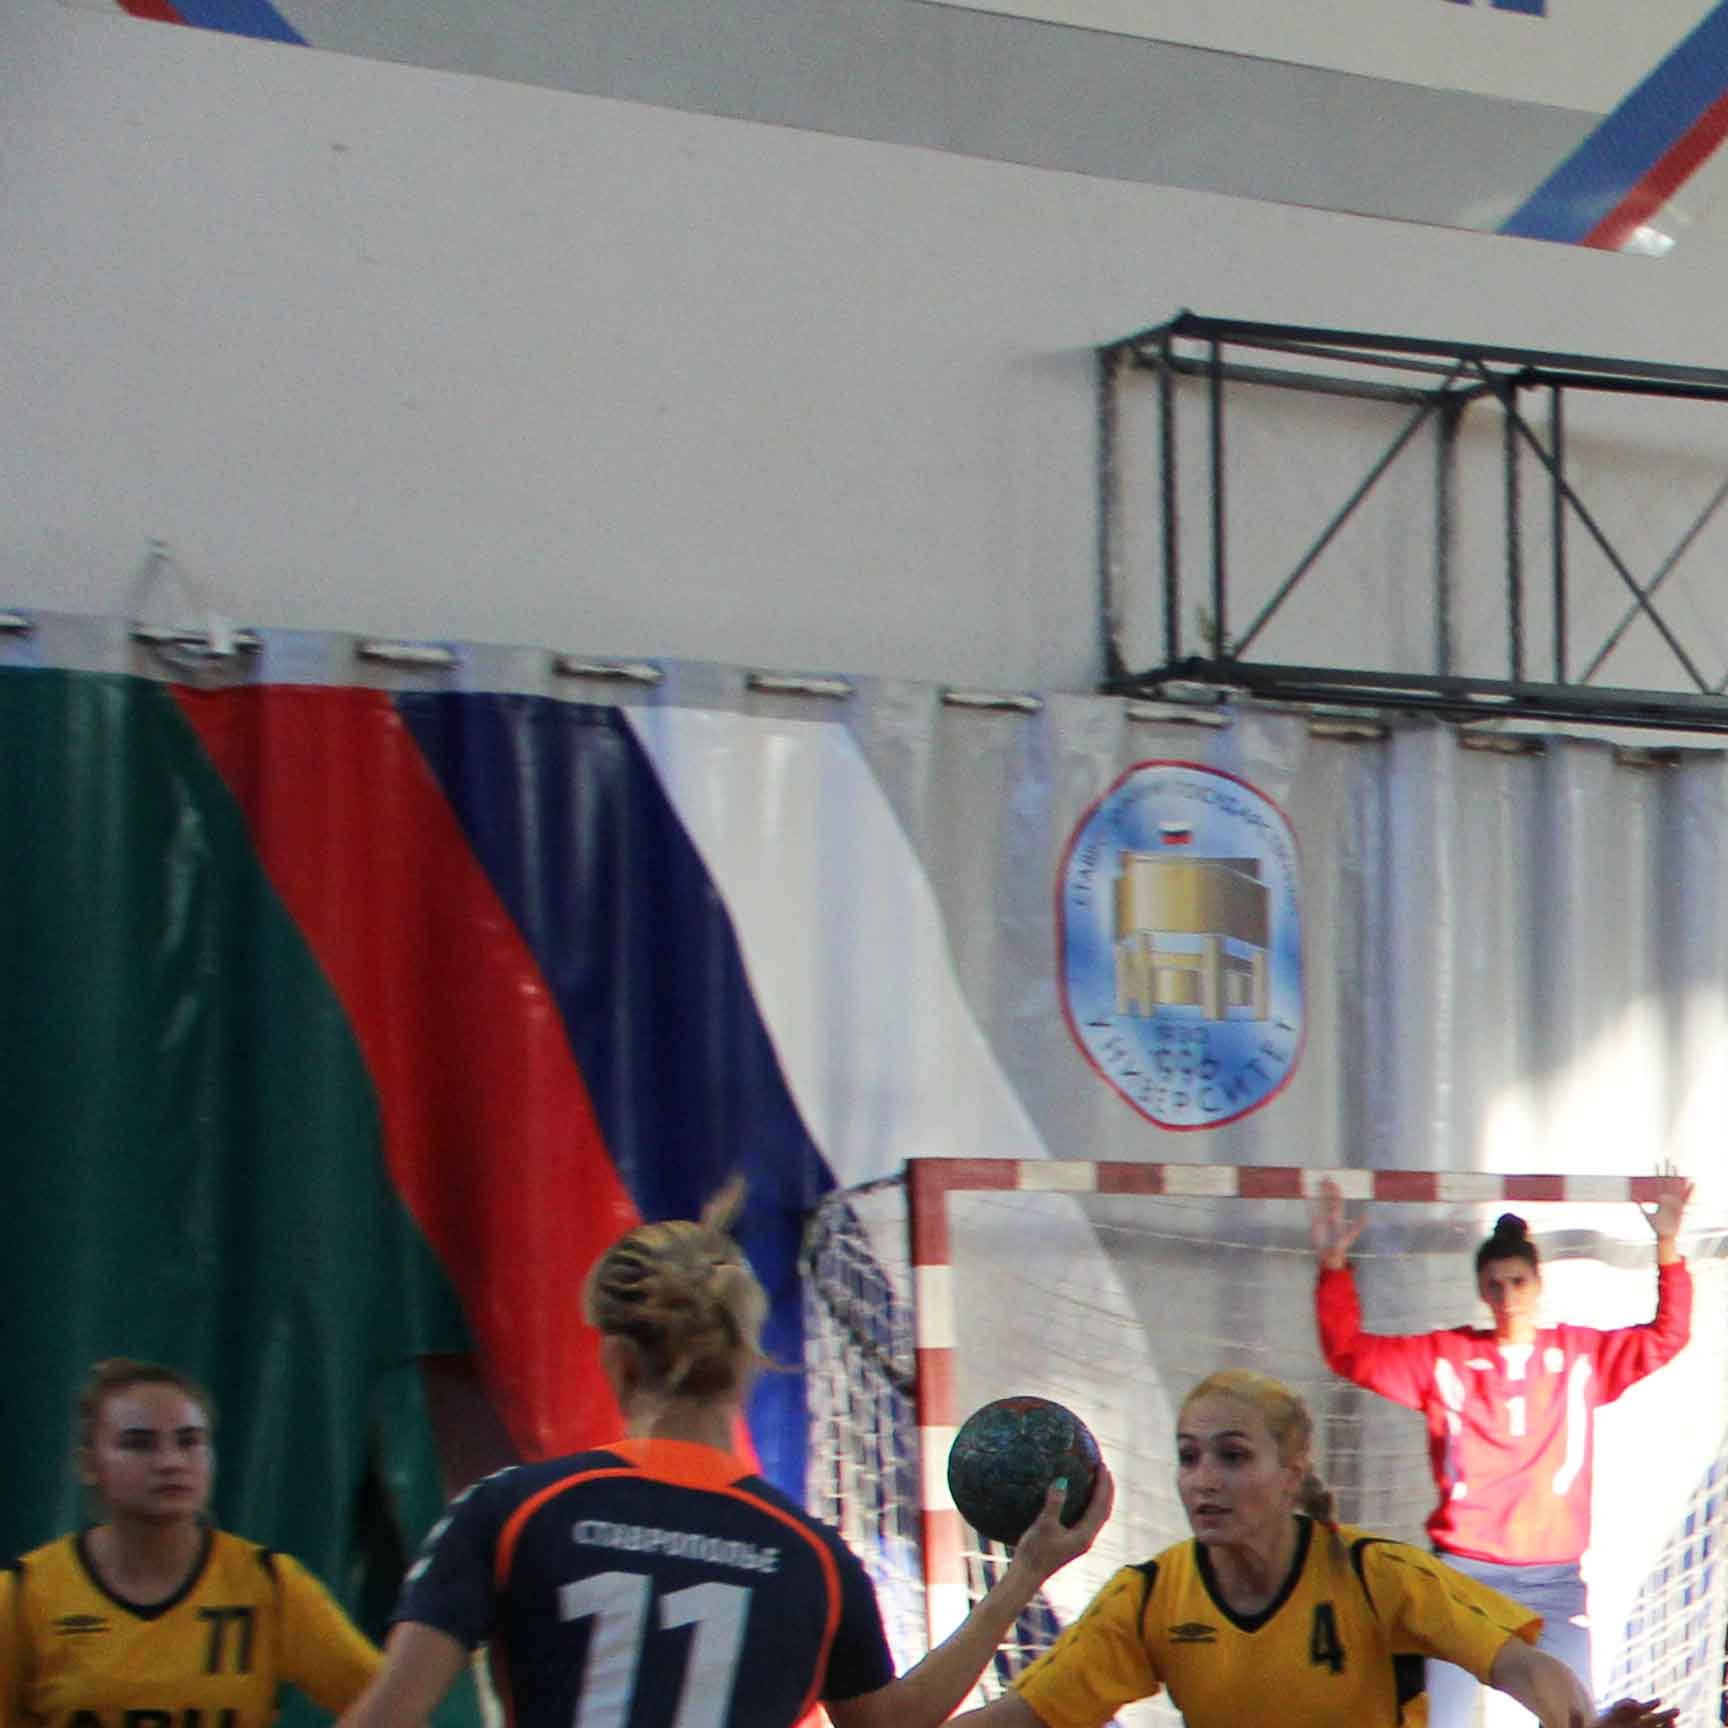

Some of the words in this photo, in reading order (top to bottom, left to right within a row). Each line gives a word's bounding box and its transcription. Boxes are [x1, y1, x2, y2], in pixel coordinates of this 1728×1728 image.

[1505, 1396, 1527, 1436] 1
[198, 1605, 257, 1675] 11
[1310, 1602, 1346, 1674] 4
